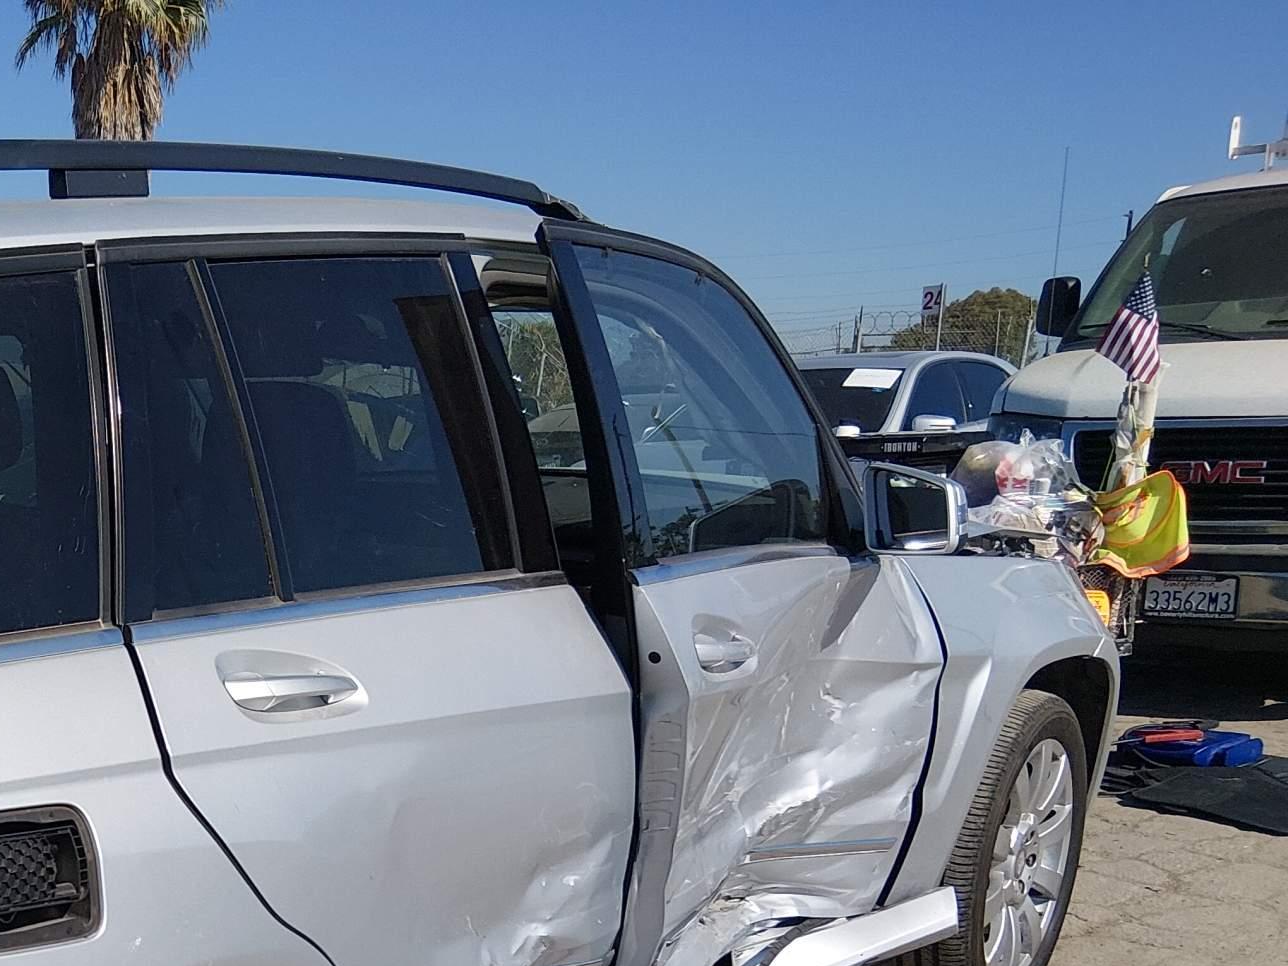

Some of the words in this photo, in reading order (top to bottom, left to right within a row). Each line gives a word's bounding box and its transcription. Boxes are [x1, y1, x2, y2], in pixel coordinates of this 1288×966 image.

[922, 291, 943, 310] 24
[1160, 460, 1267, 484] GMC
[1148, 590, 1232, 613] 33562M3
